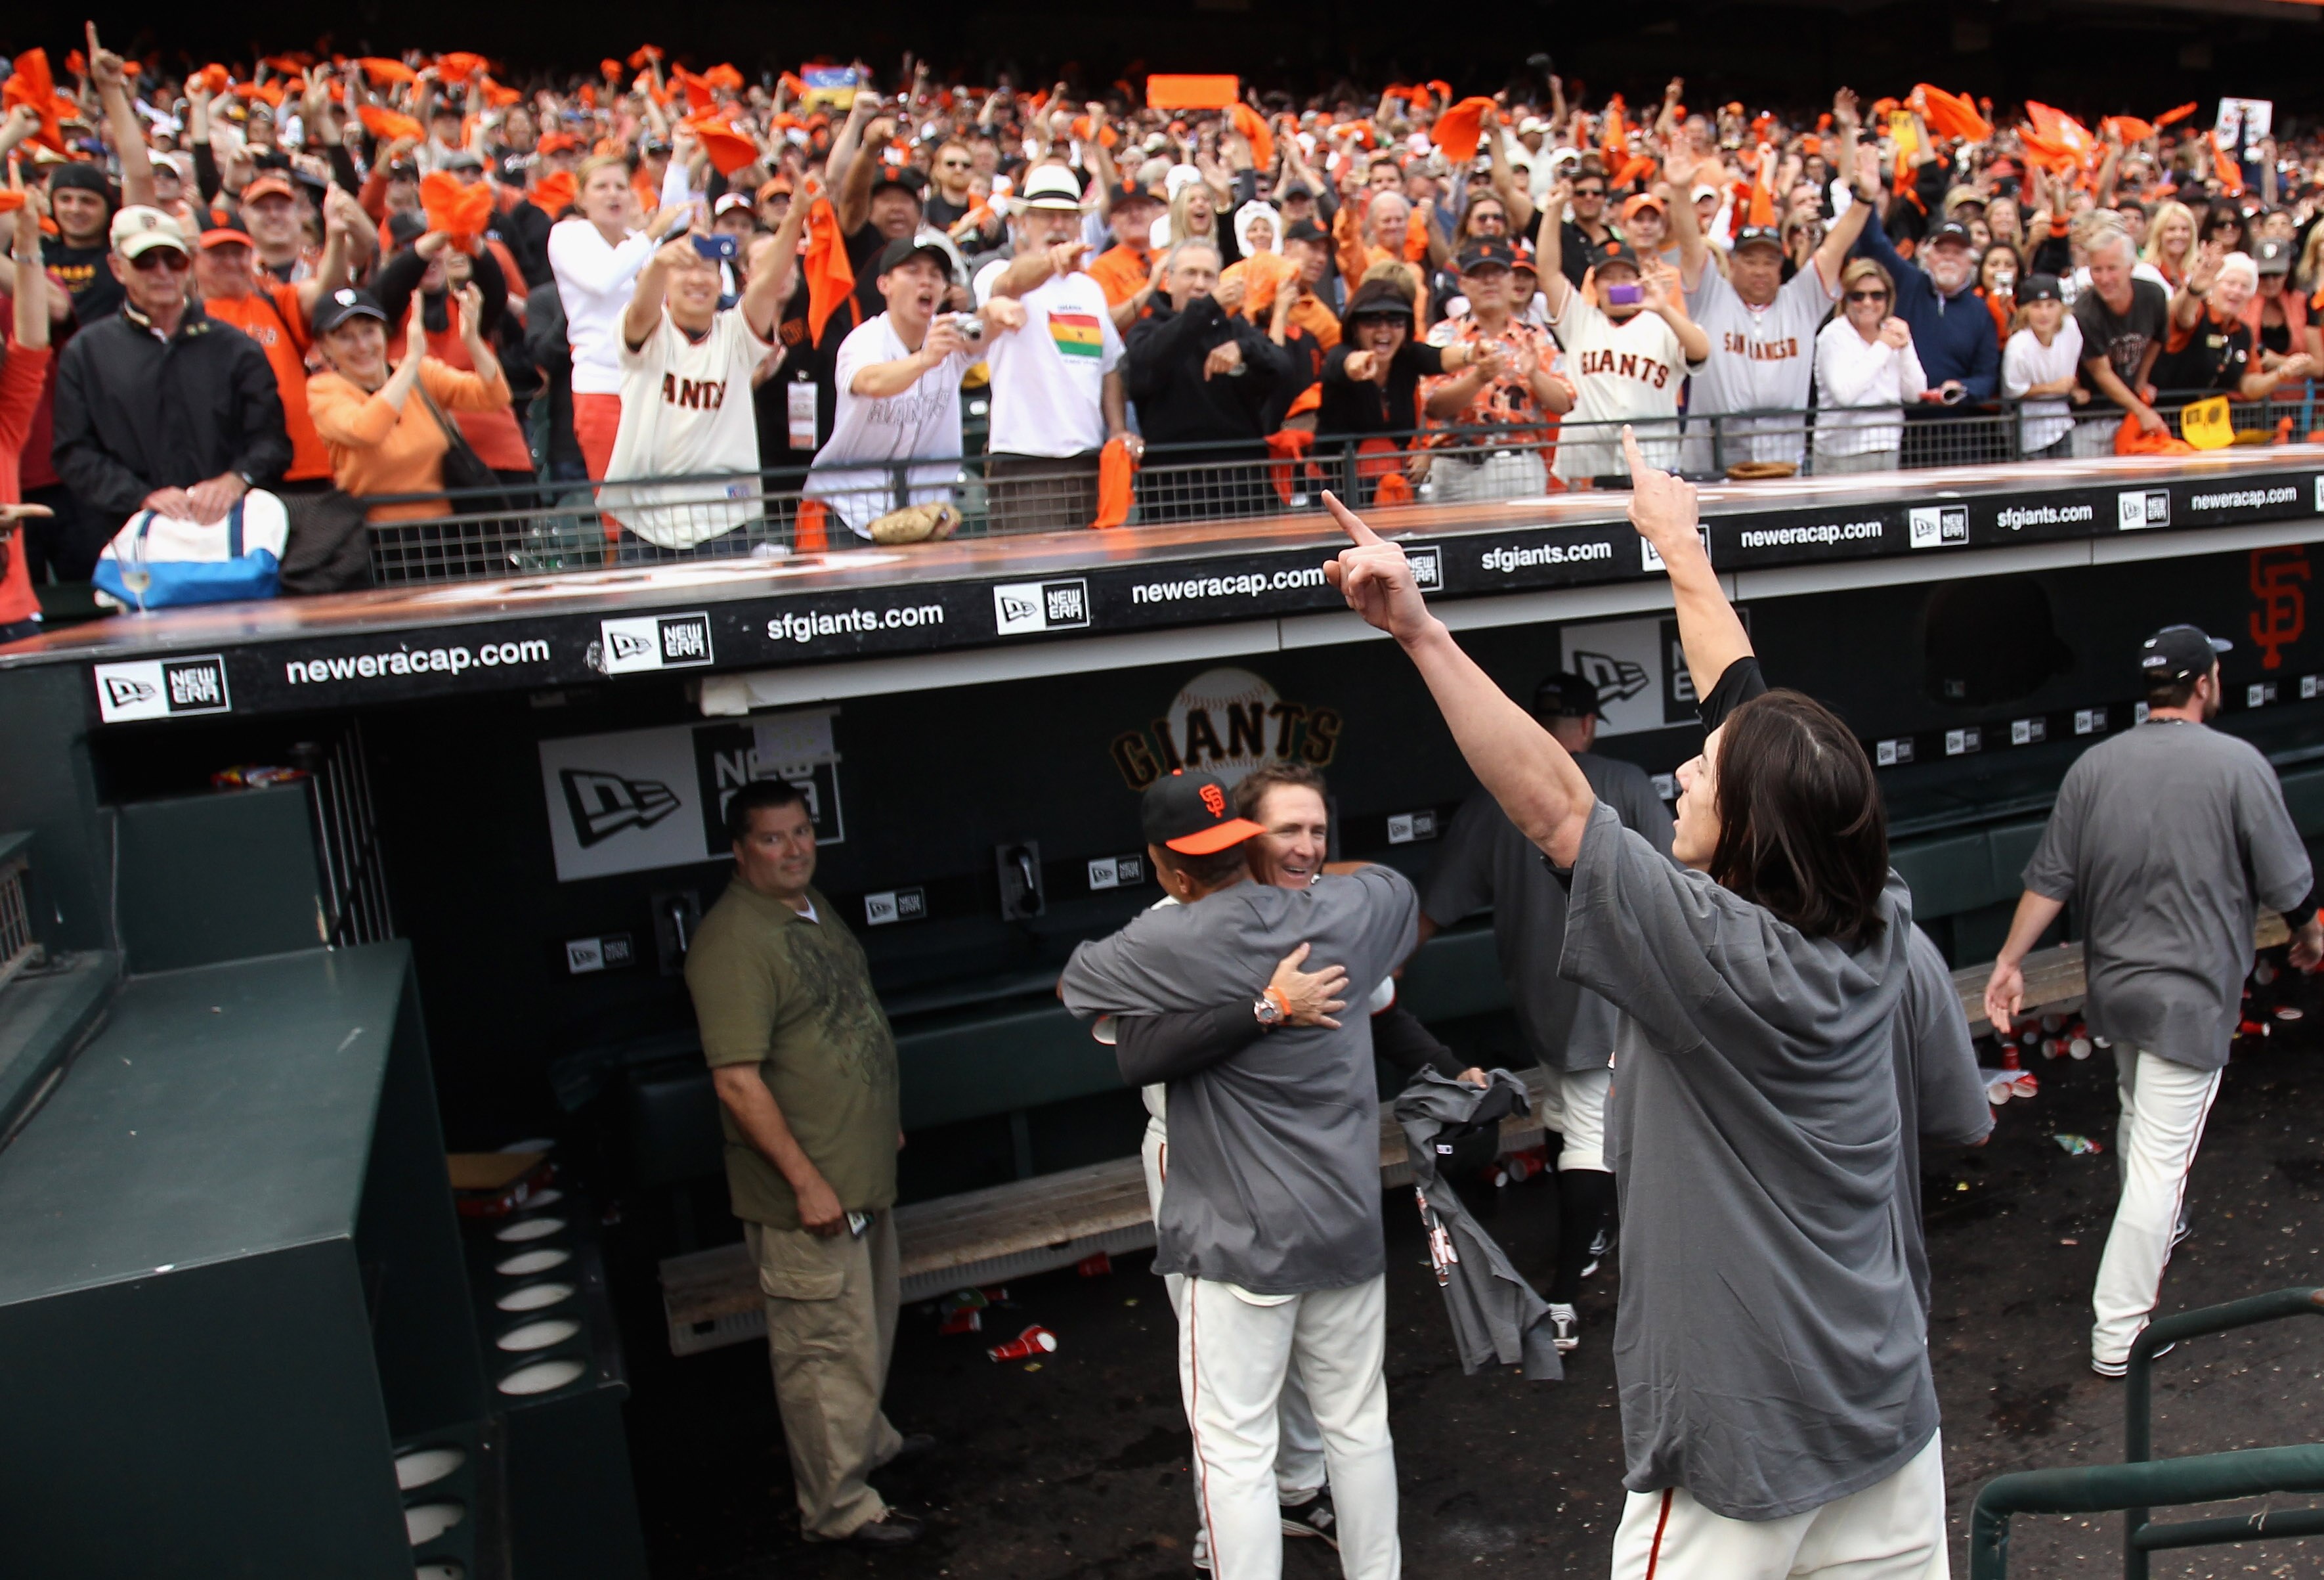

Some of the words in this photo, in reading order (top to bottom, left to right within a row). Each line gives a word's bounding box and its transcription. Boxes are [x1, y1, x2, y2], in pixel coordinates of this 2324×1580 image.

[2191, 486, 2297, 511] neweracap.com
[1942, 512, 1964, 527] NEW
[1996, 504, 2093, 531] sfgiants.com
[1741, 520, 1882, 548] neweracap.com
[1943, 524, 1965, 538] ERA
[1481, 540, 1612, 573] sfgiants.com
[1047, 589, 1081, 605] NEW
[1132, 567, 1325, 604] neweracap.com
[1049, 603, 1083, 620] ERA
[663, 623, 702, 642] NEW
[767, 604, 943, 643] sfgiants.com
[666, 640, 706, 657] ERA
[286, 638, 550, 684] neweracap.com
[169, 667, 217, 688] NEW
[173, 683, 221, 704] ERA
[1109, 700, 1343, 791] GIANTS
